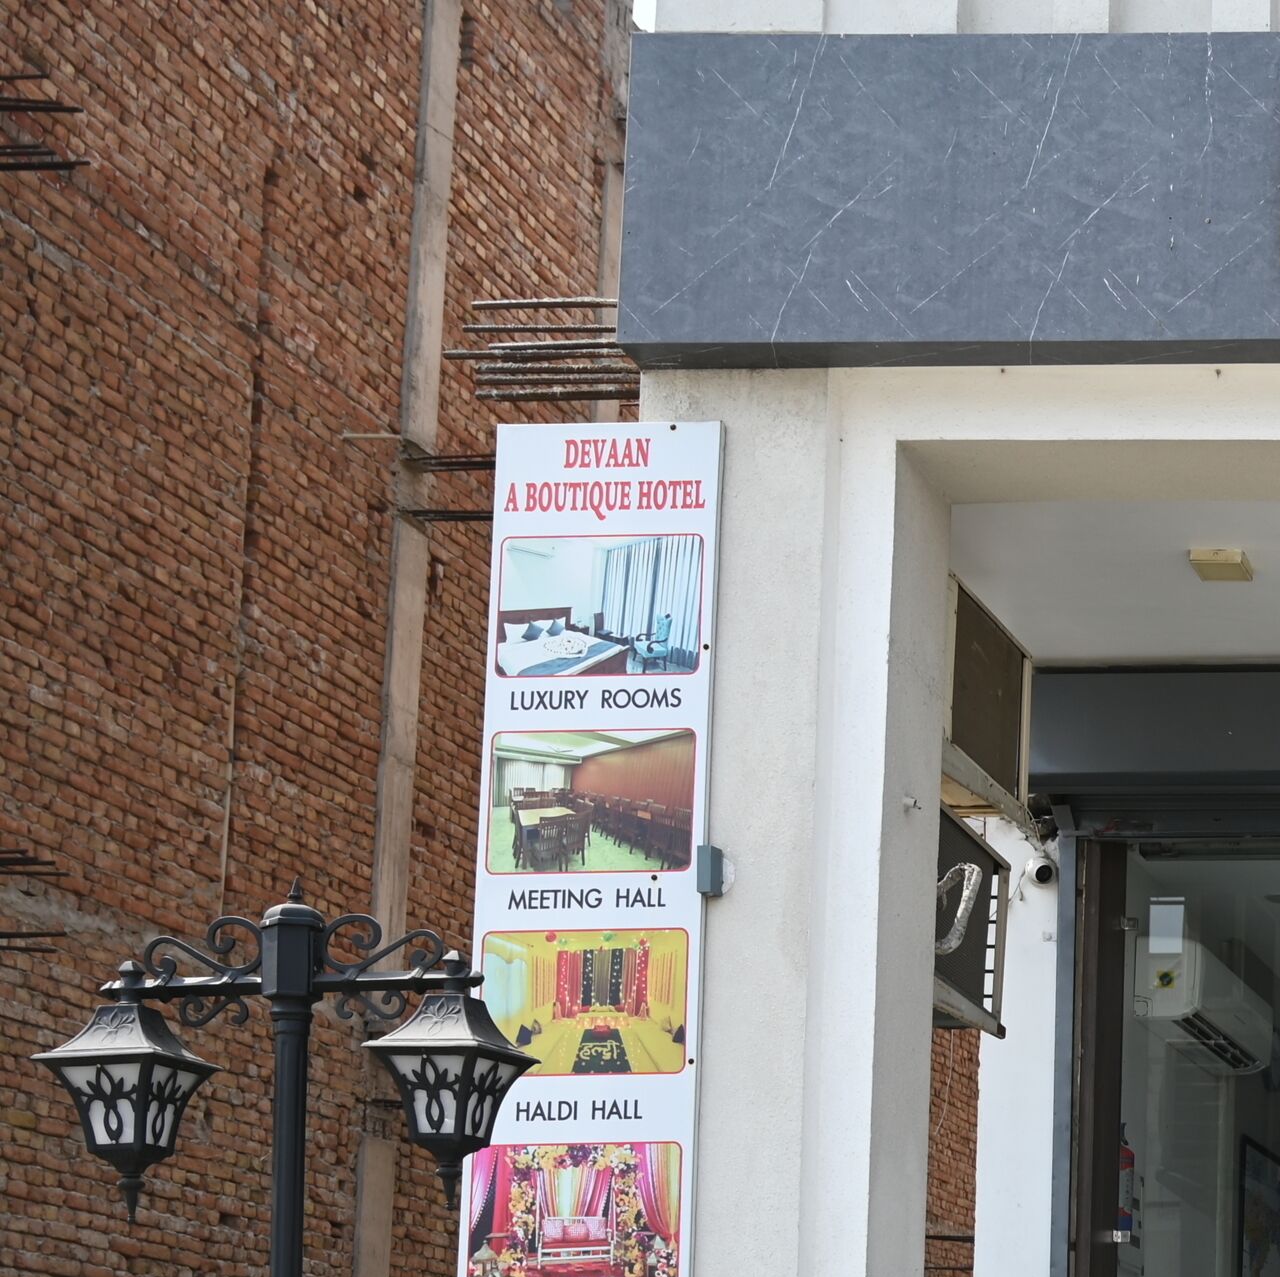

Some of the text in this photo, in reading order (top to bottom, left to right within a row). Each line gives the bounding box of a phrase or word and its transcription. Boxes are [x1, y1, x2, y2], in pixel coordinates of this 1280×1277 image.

[563, 437, 651, 469] DEVAAN
[503, 479, 706, 521] A BOUTIQUE HOTEL
[510, 687, 682, 711] LUXURY ROOMS
[508, 886, 666, 911] MEETING HALL
[515, 1099, 643, 1122] HALDI HALL
